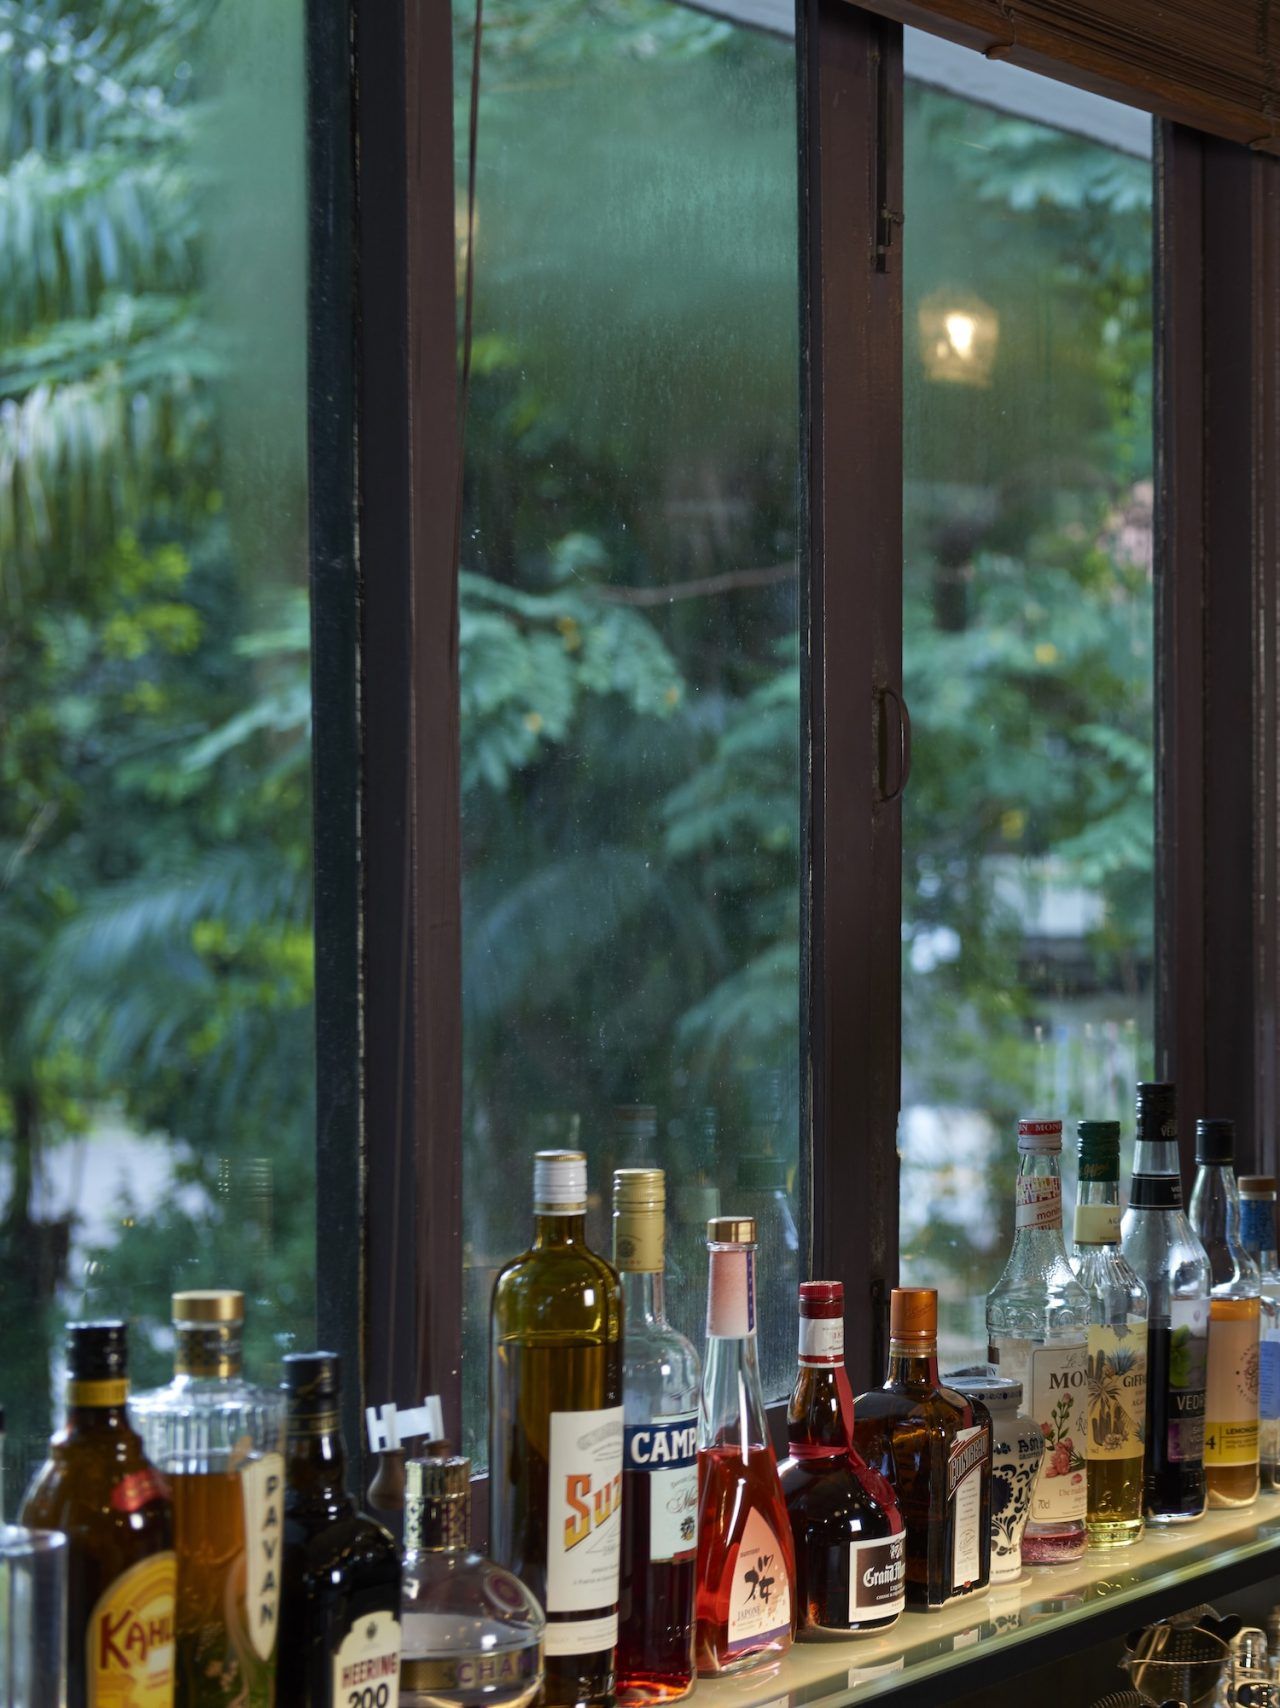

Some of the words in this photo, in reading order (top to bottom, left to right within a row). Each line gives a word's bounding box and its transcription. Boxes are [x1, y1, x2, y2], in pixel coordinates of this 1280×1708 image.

[631, 1427, 698, 1464] CAMP
[1205, 1435, 1217, 1450] 4
[261, 1474, 281, 1626] PAVAN
[341, 1652, 398, 1690] HEERING
[348, 1682, 389, 1708] 200
